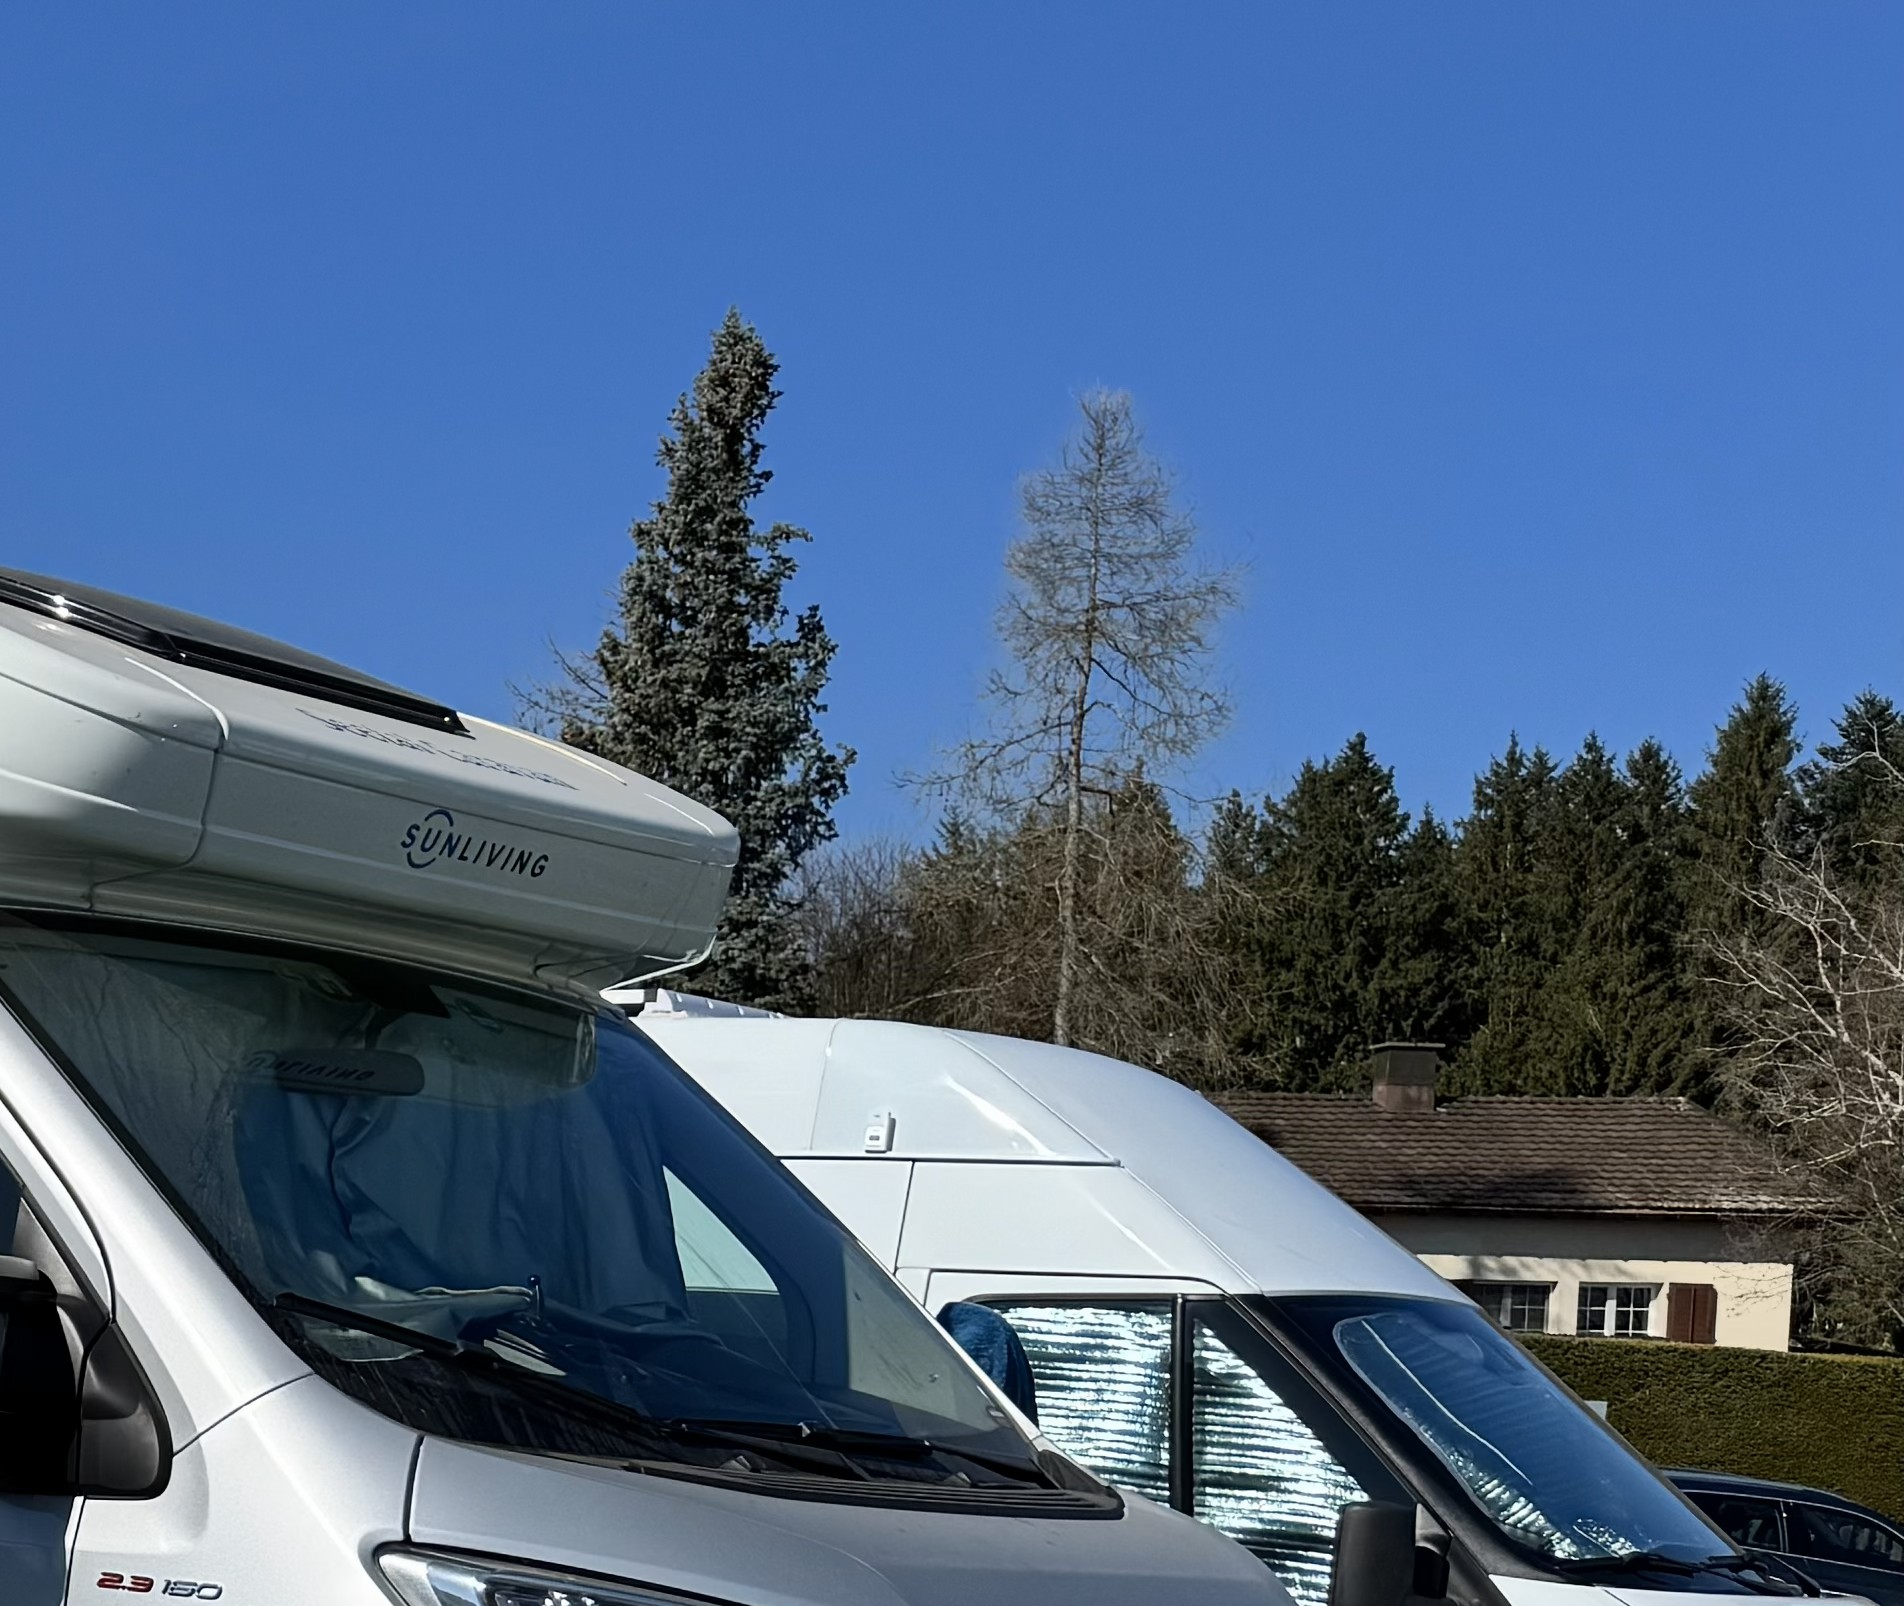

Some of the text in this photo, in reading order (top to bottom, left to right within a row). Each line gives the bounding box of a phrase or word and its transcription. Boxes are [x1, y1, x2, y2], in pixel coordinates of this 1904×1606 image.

[400, 822, 549, 878] SUNLIVING
[96, 1571, 223, 1601] 2.3 150
